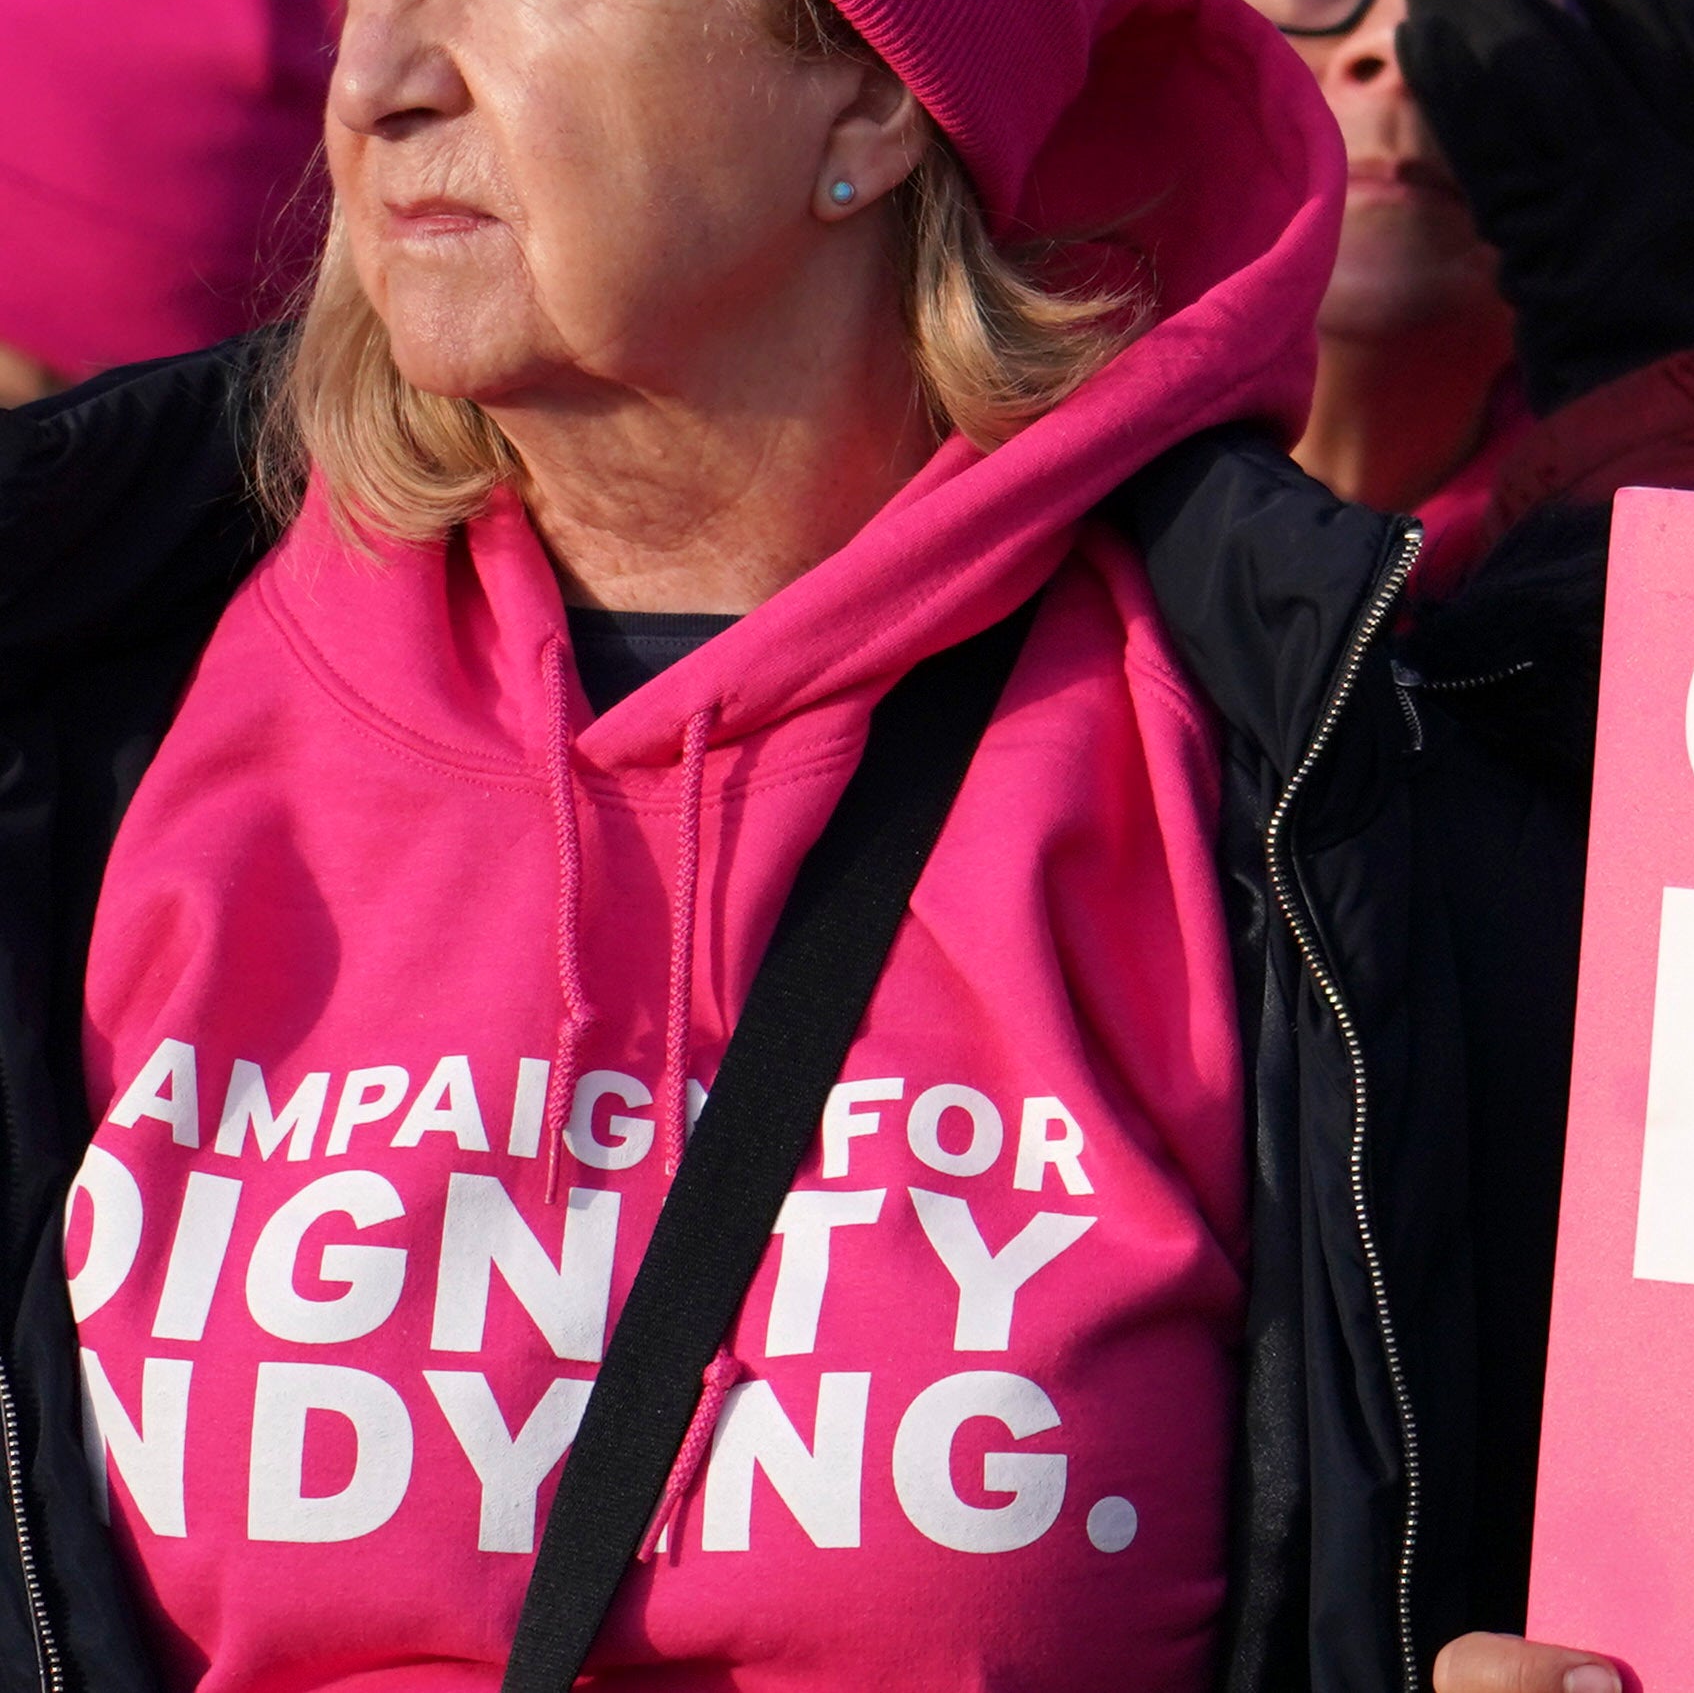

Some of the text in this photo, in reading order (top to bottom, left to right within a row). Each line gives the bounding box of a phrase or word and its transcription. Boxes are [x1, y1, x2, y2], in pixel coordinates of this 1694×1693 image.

[109, 1037, 1094, 1196] AMPAIG FOR
[64, 1144, 1098, 1363] DIGNTY
[80, 1346, 1139, 1554] N DYNG.
